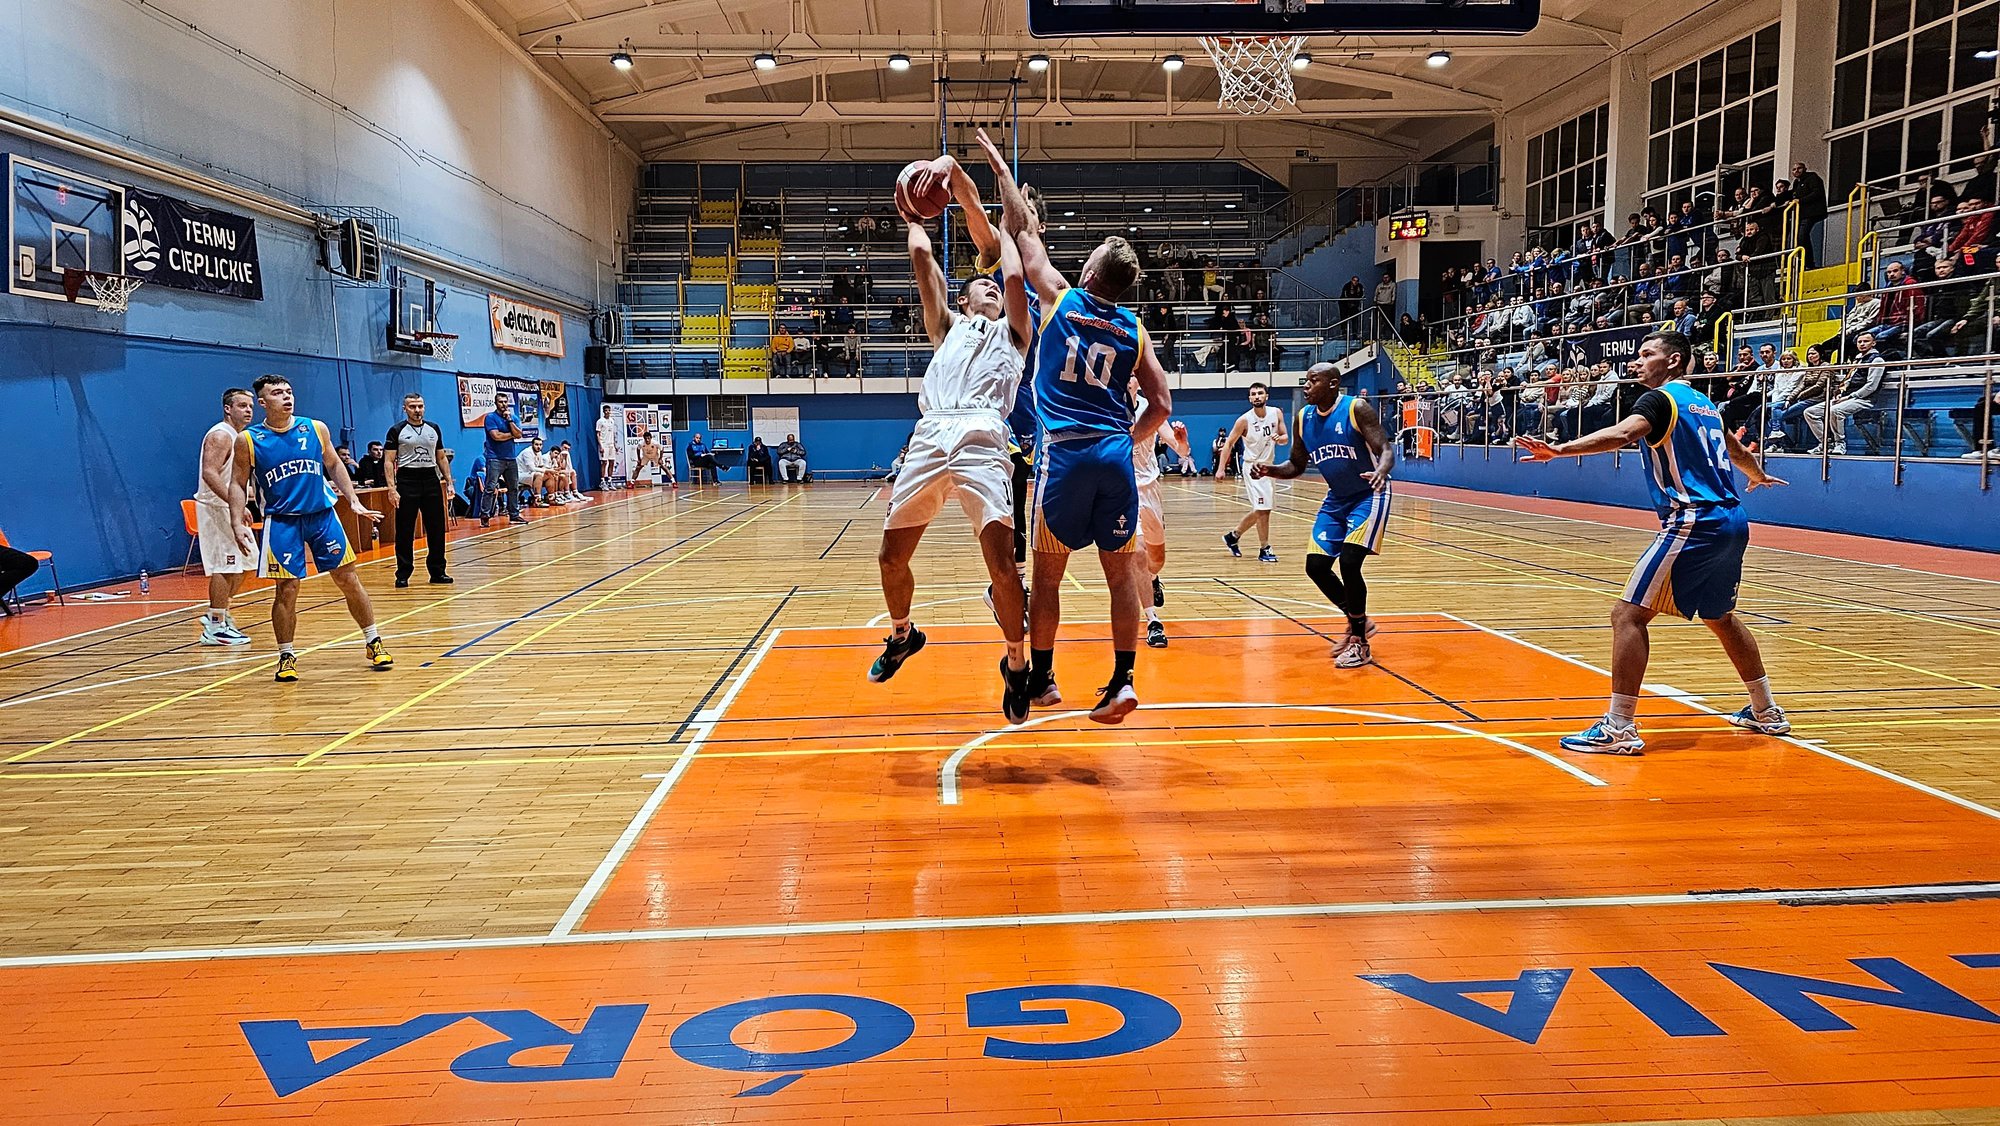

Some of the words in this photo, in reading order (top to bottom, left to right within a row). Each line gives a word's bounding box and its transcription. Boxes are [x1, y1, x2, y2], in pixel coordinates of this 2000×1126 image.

[182, 218, 236, 250] TERMY
[168, 248, 253, 284] CIEPLICKIE
[1600, 339, 1636, 358] TERMY
[1060, 335, 1117, 390] 10
[1335, 422, 1343, 434] 4
[298, 437, 307, 450] 7
[1698, 426, 1731, 471] 12
[283, 553, 292, 565] 7
